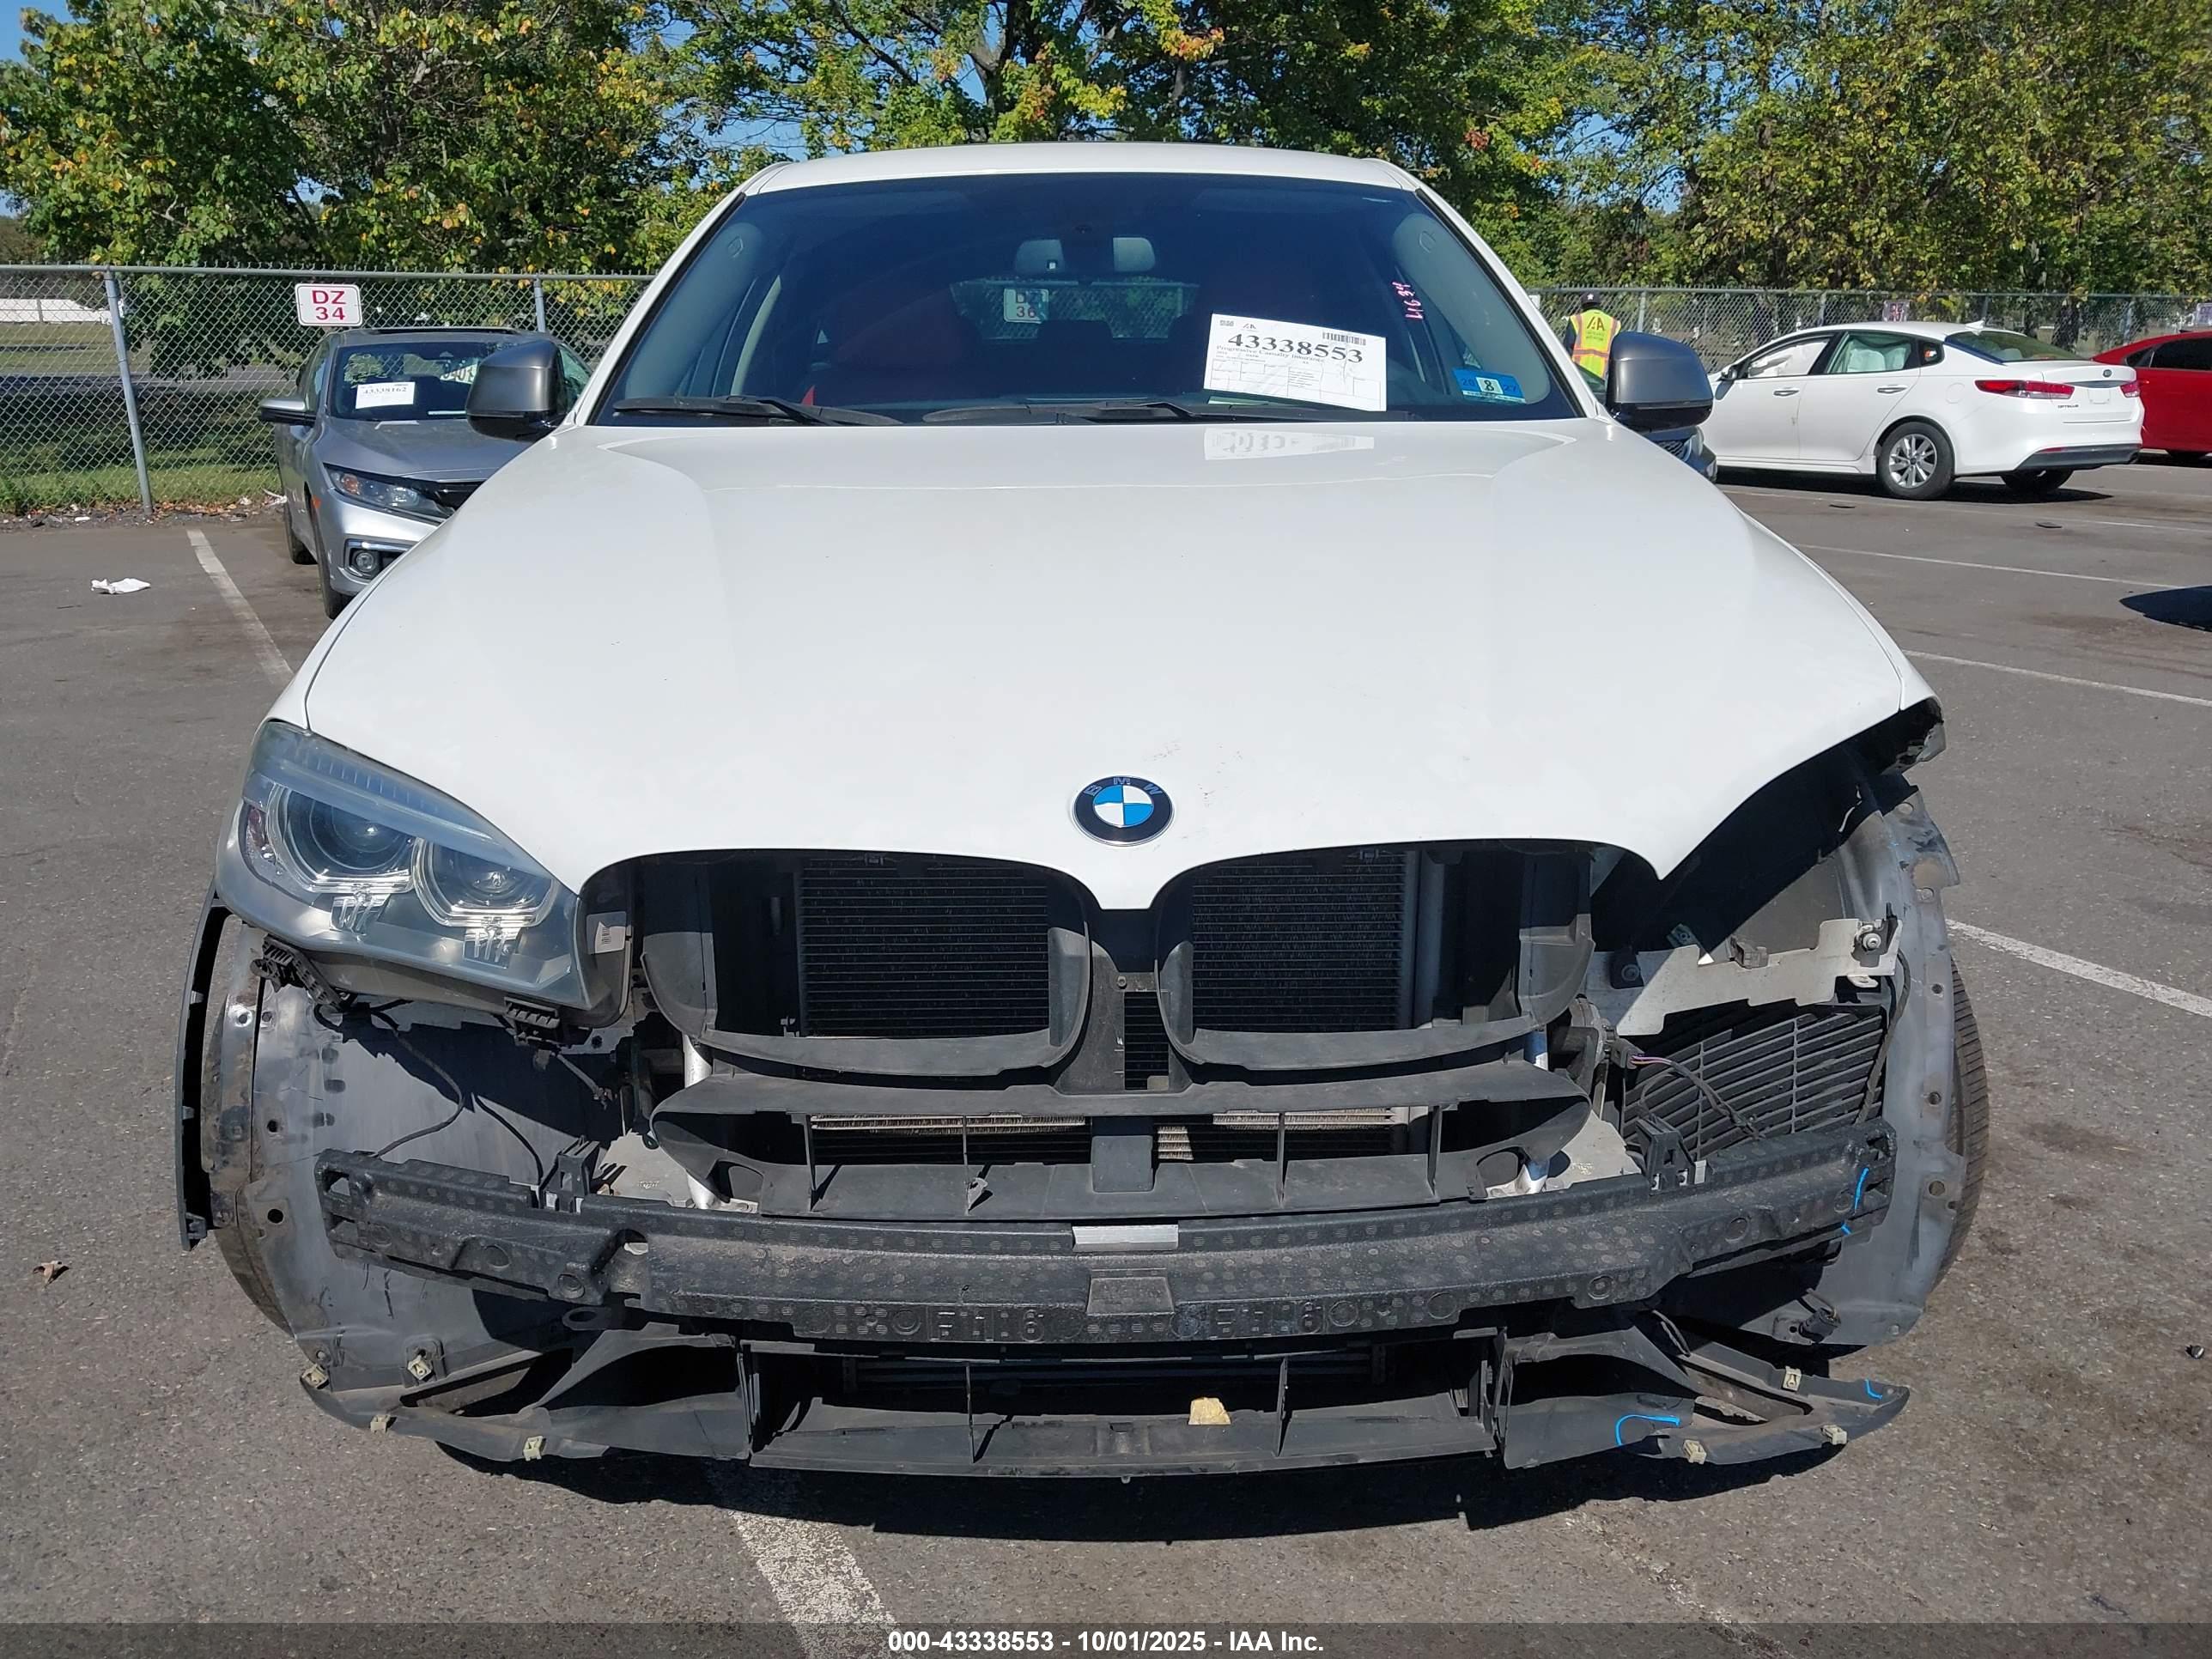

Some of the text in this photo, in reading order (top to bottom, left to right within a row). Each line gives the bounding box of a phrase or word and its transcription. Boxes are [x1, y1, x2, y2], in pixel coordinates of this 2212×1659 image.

[312, 290, 345, 304] DZ
[316, 307, 345, 320] 34
[1017, 307, 1036, 318] 36
[1228, 333, 1364, 363] 43338553
[1484, 380, 1495, 392] 8
[1083, 777, 1163, 797] BMW
